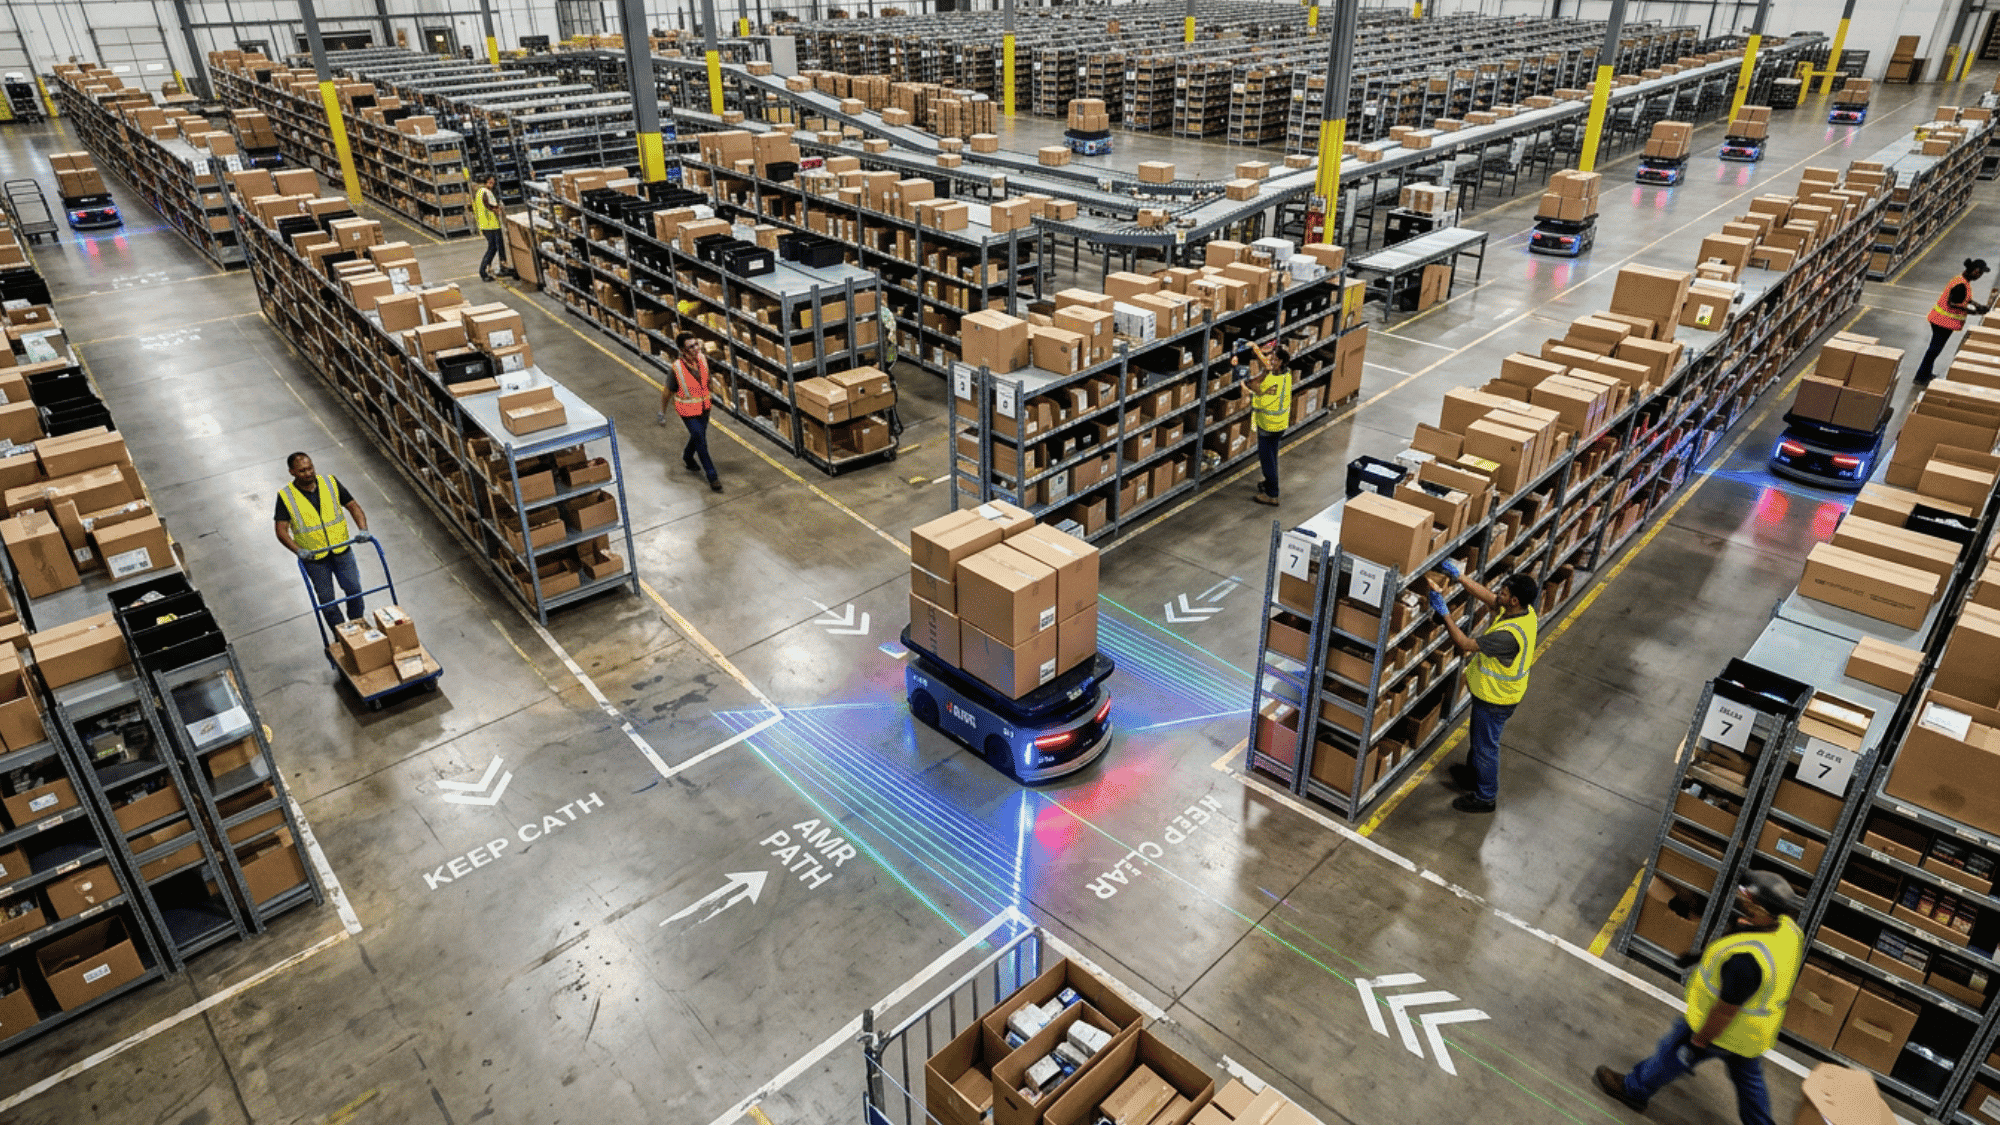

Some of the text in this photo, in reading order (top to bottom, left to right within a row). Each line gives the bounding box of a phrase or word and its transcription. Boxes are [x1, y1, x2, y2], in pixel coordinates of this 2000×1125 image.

[1290, 554, 1299, 569] 7
[1363, 581, 1371, 595] 7
[1721, 720, 1734, 737] 7
[1818, 763, 1832, 779] 7
[422, 792, 605, 890] KEEP CATH
[792, 818, 857, 868] AMR
[759, 829, 834, 891] PATH
[1085, 841, 1164, 899] CLEAR
